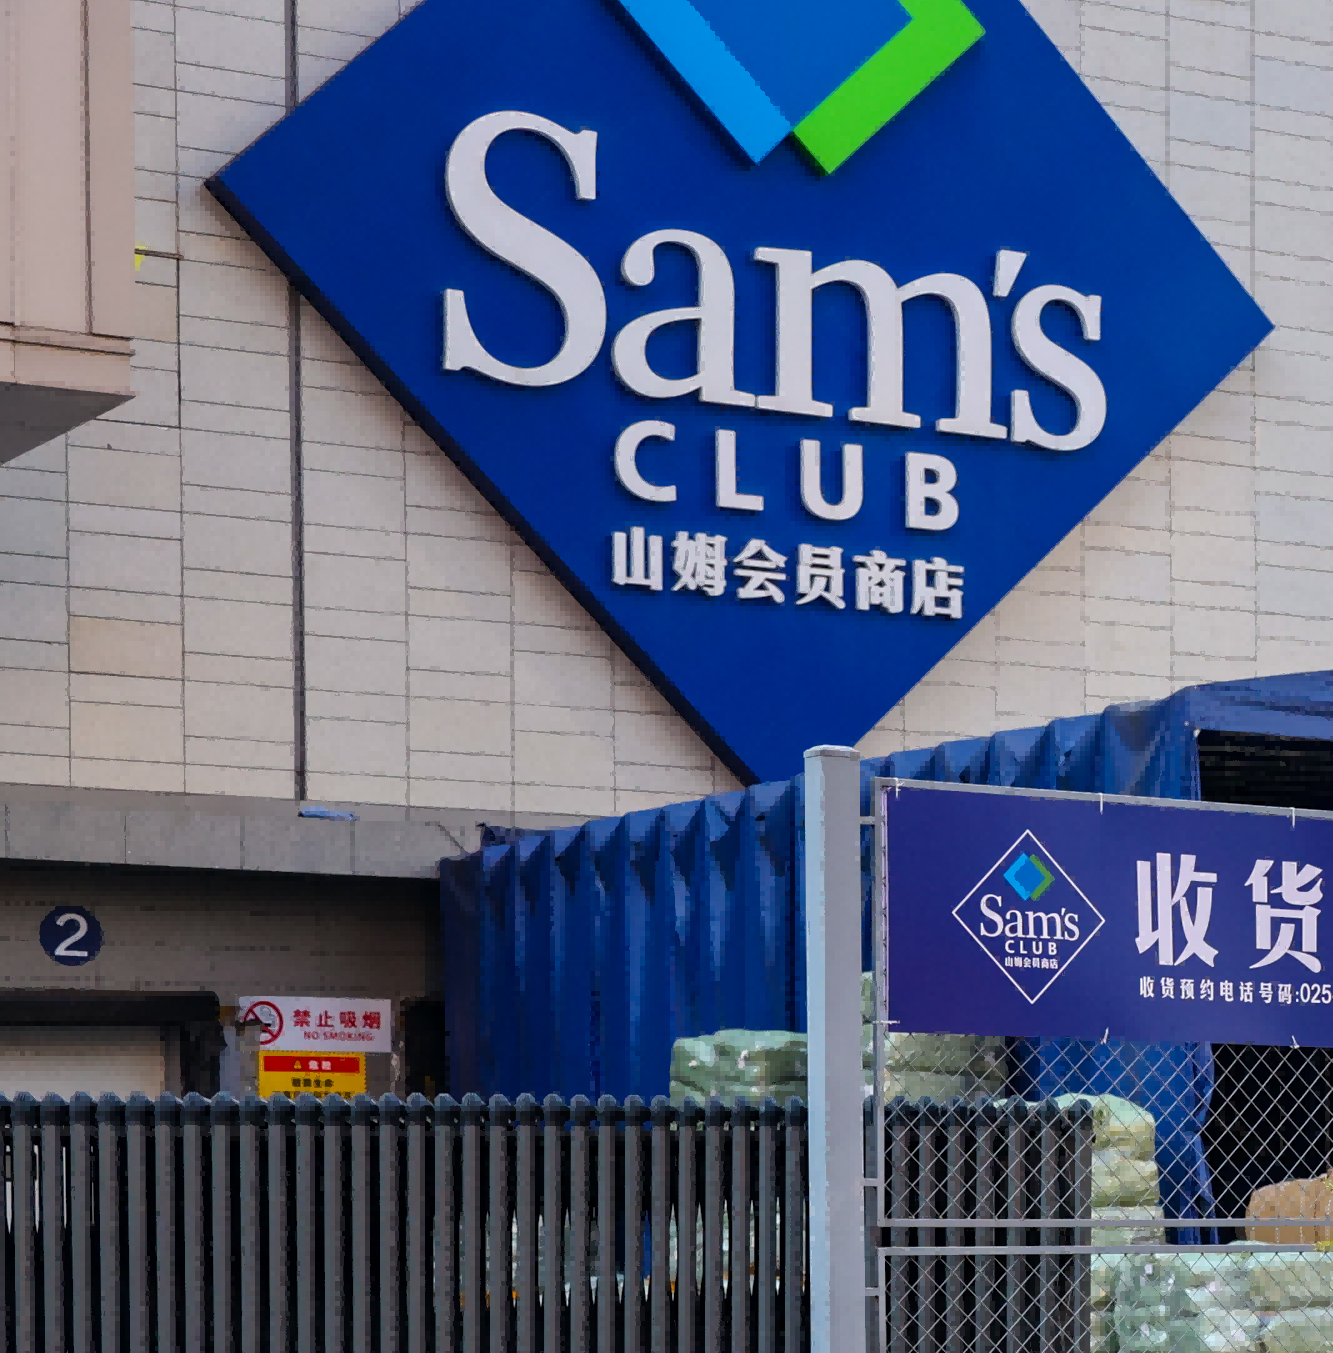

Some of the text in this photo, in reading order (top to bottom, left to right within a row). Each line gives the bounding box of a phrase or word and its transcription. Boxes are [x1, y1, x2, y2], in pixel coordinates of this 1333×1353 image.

[442, 109, 1108, 452] Sam's
[612, 418, 961, 531] CLUB
[610, 526, 965, 619] 山姆会员商店
[54, 912, 89, 957] 2
[979, 893, 1081, 942] Sam's
[1004, 939, 1058, 956] CLUB
[1004, 956, 1059, 970] 山姆会员商店
[292, 1008, 381, 1031] 禁止吸烟
[303, 1030, 376, 1042] NO SMOKING
